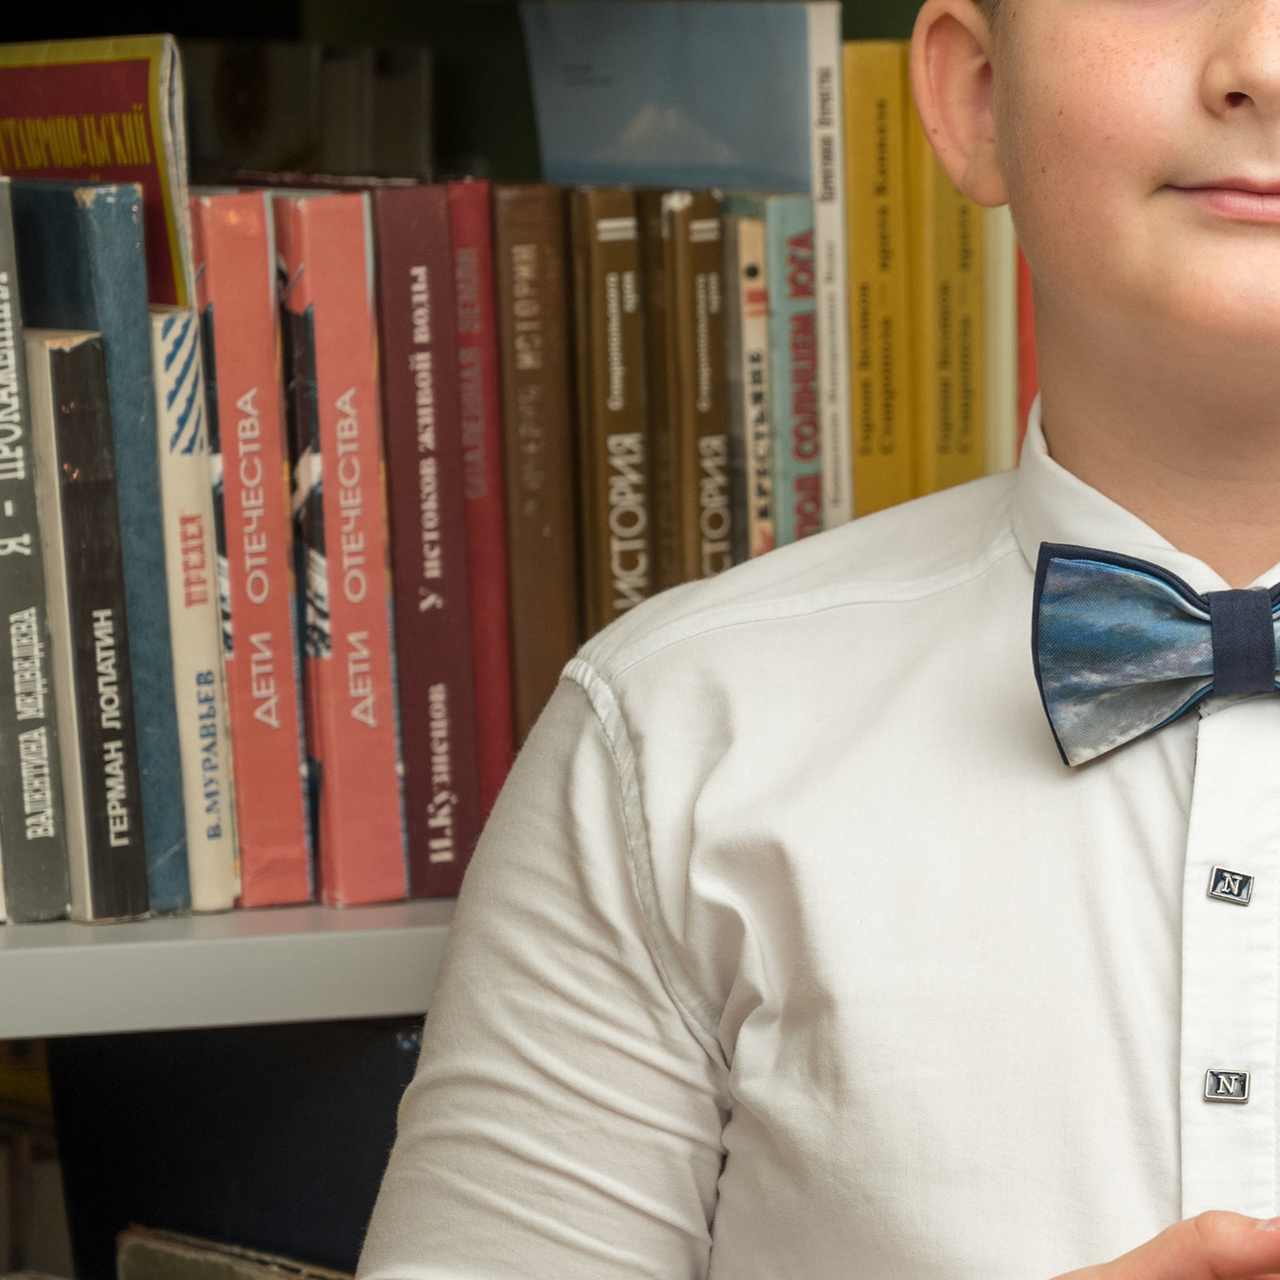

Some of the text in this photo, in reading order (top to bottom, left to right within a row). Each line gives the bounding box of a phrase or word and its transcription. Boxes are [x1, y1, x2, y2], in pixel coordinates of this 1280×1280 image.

[785, 228, 814, 299] ЮГА
[409, 265, 442, 611] У истоков живой воды
[605, 431, 649, 610] ИСТОРИЯ
[698, 434, 734, 580] СТОРИЯ
[235, 387, 279, 727] ДЕТИ ОТЕЧЕСТВА
[334, 387, 376, 726] ДЕТИ ОТЕЧЕСТВА
[9, 606, 54, 839] ВАЛЕНТИНА МЕДВЕДЕВА
[92, 608, 129, 847] ГЕРМАН ЛОПАТИН
[1220, 872, 1243, 896] N
[1216, 1075, 1238, 1095] N
